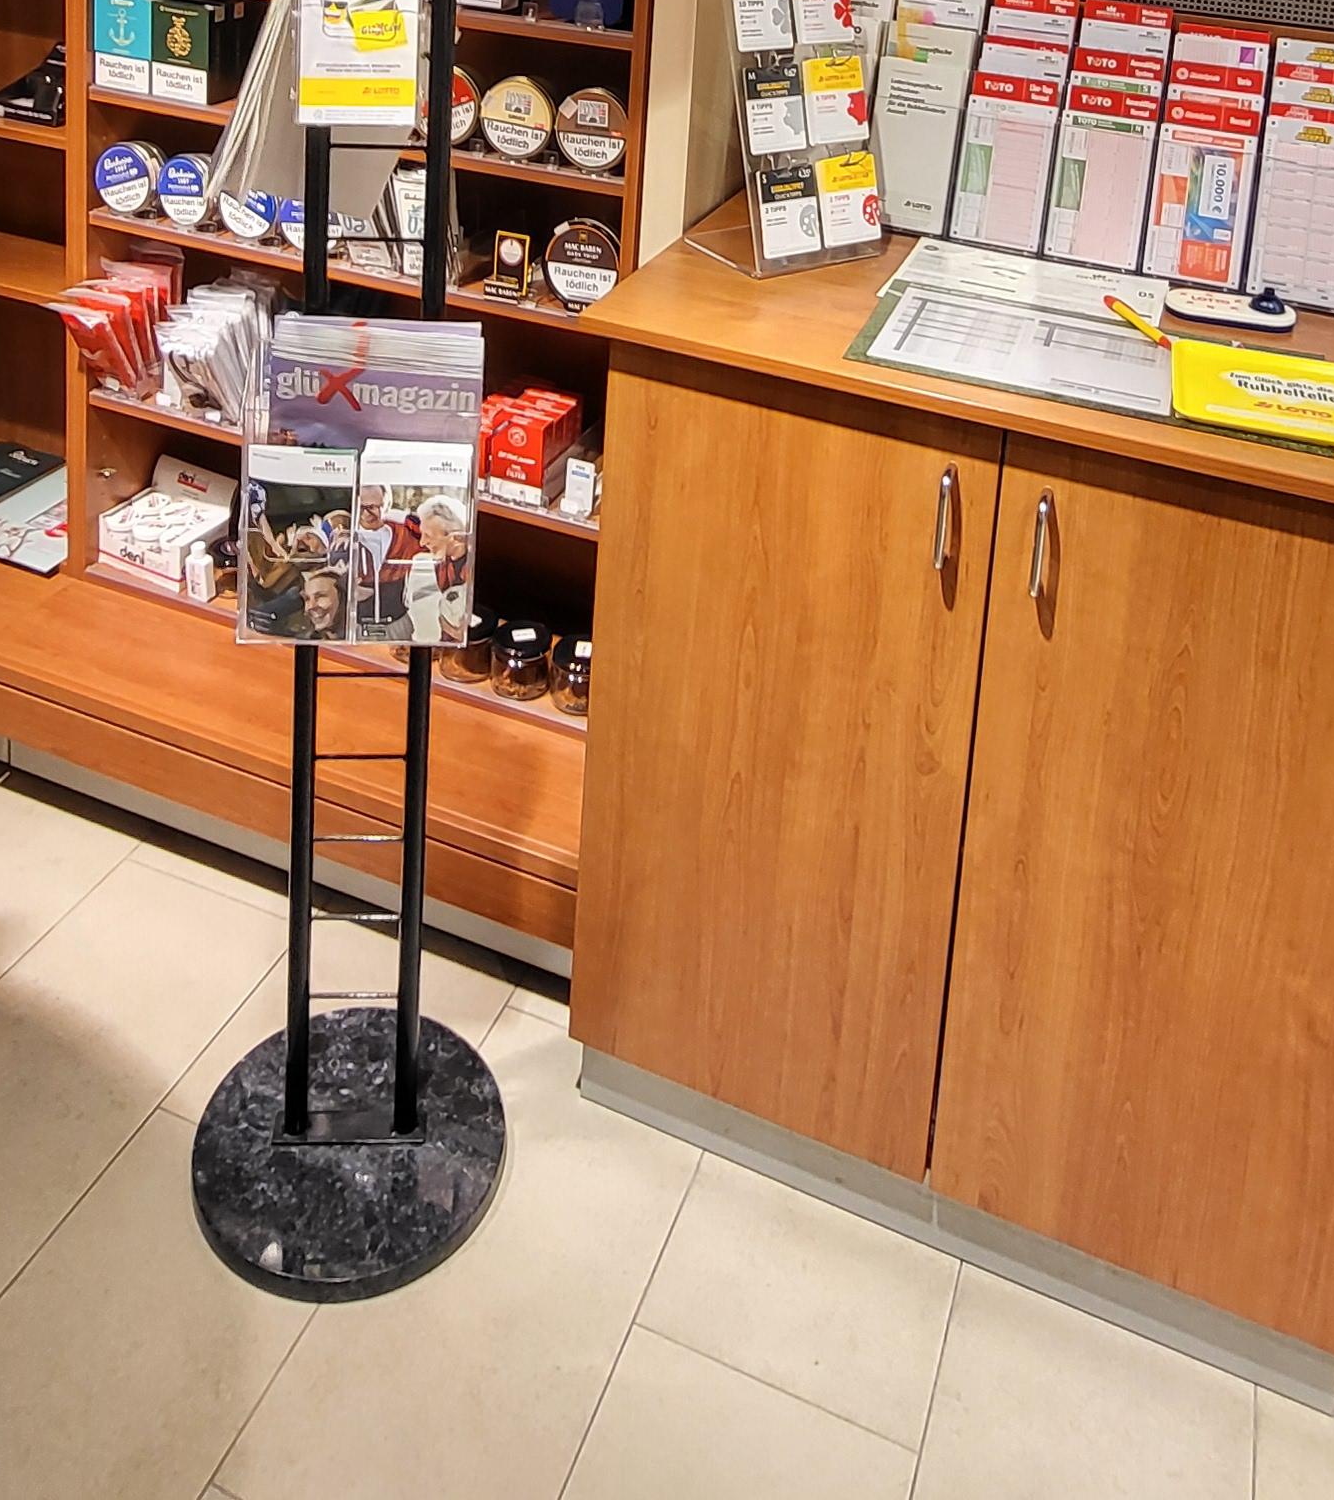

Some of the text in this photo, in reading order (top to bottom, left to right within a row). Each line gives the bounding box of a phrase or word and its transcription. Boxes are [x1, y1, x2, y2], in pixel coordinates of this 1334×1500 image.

[1086, 56, 1117, 69] TOTO
[984, 80, 1014, 93] TOTO
[1081, 94, 1112, 107] TOTO
[487, 121, 528, 138] Rauchen
[497, 134, 529, 150] tödlich
[1214, 163, 1227, 203] 10.000
[564, 241, 602, 254] MAC BAREN
[553, 265, 597, 281] Rauchen
[1254, 375, 1283, 387] Glück
[1277, 404, 1332, 419] LOTTO
[120, 546, 145, 565] deni
